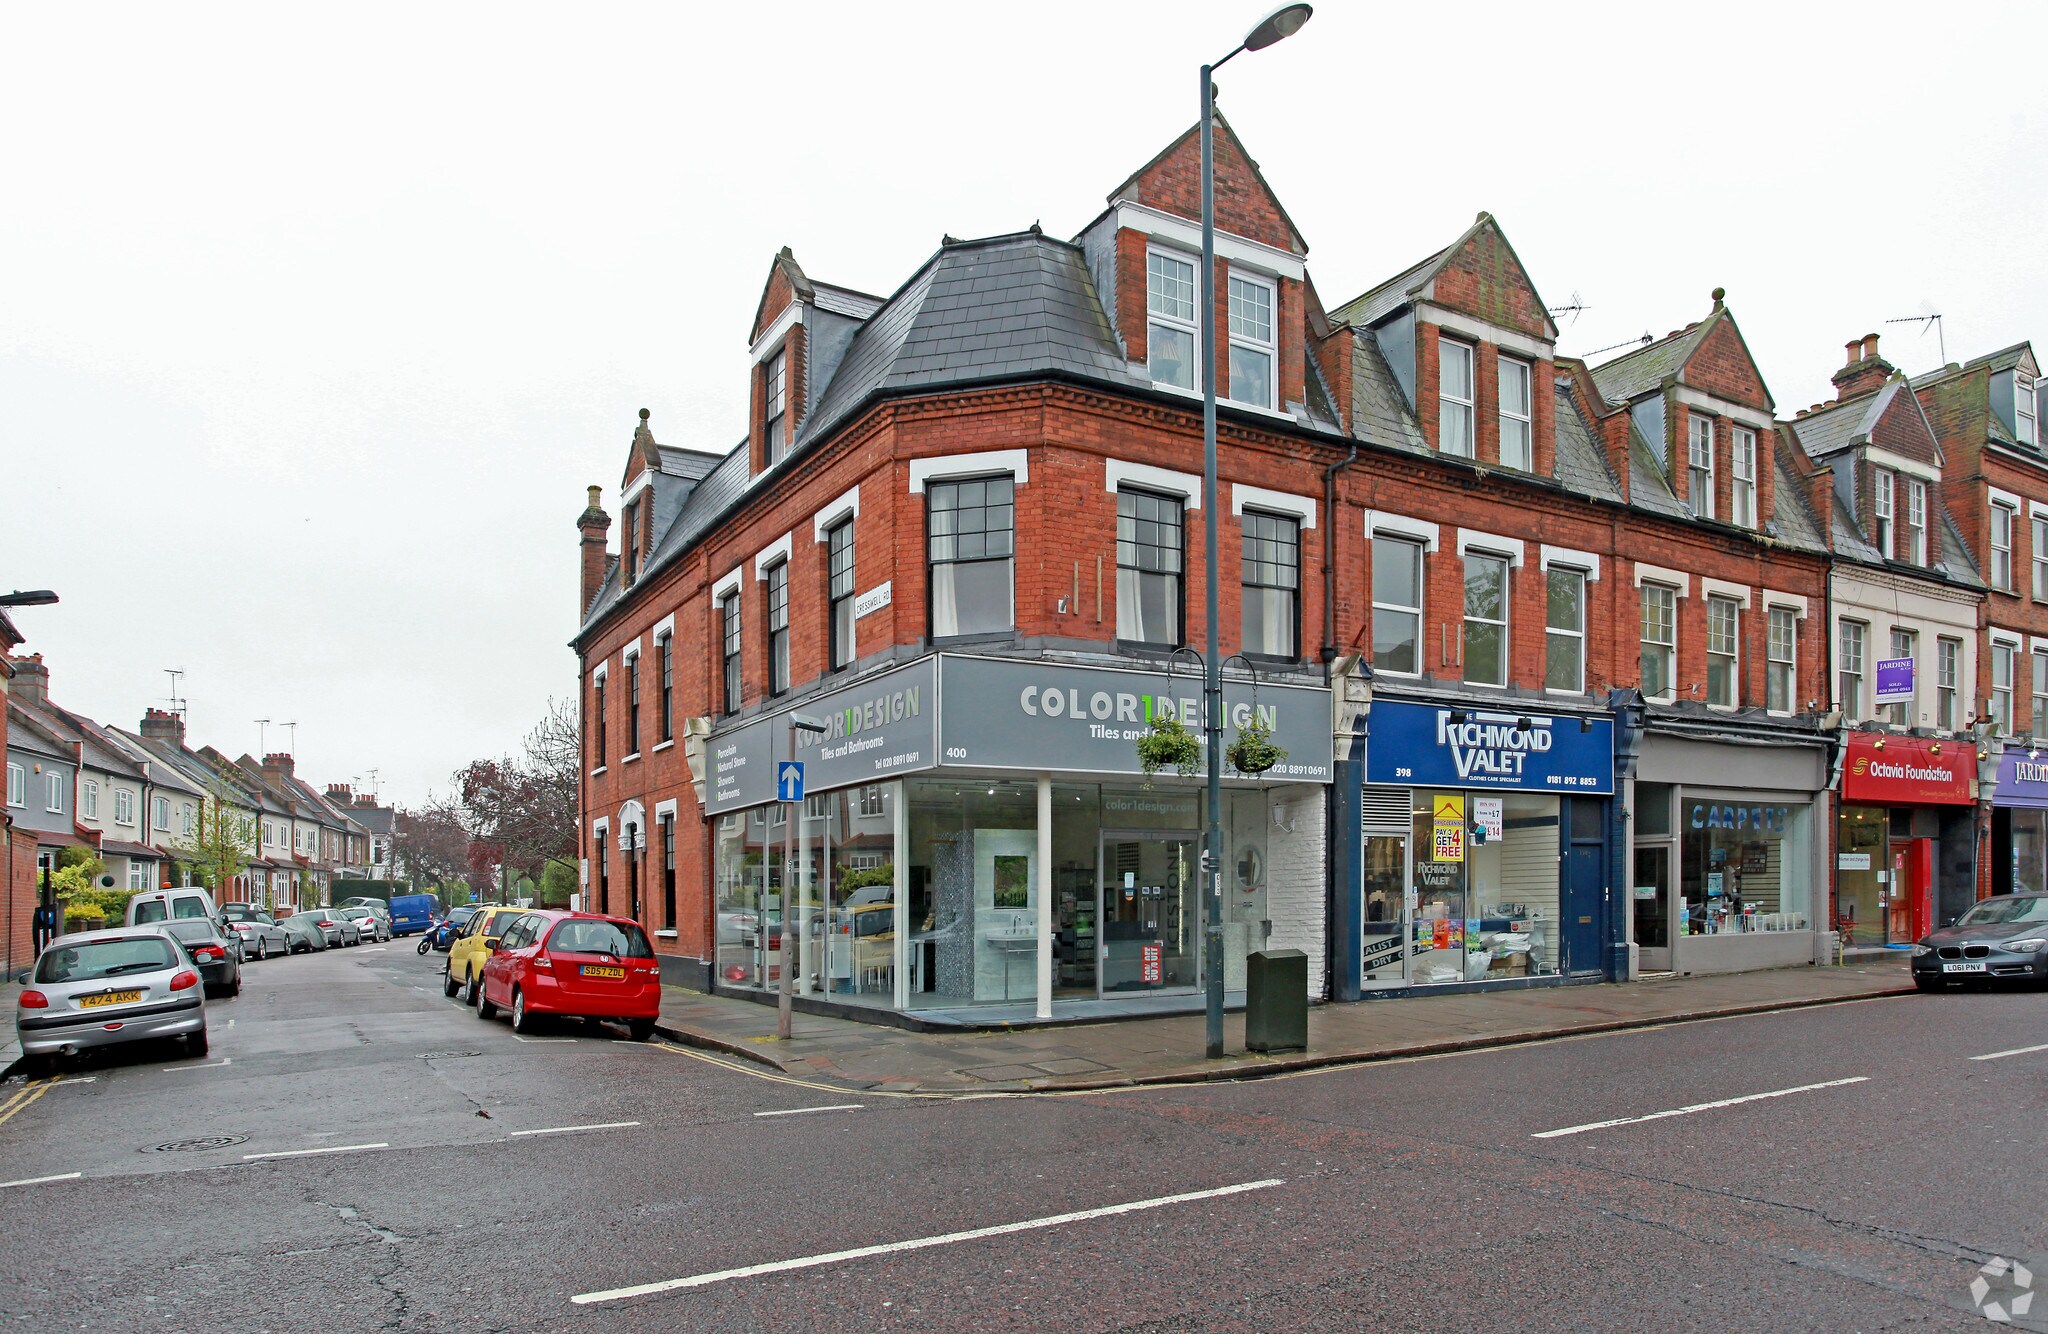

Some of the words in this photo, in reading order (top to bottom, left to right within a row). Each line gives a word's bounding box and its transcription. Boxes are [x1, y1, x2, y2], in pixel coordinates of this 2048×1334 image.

[1879, 661, 1911, 671] JARDINE
[1020, 686, 1277, 732] COLOR1DEIGN
[1090, 724, 1120, 740] Tiles
[1437, 711, 1552, 750] RICHMOND
[718, 744, 737, 759] Porcelain
[820, 747, 835, 761] Tiles
[835, 742, 848, 758] and
[848, 736, 884, 755] Bathrooms
[946, 747, 967, 758] 400
[718, 757, 734, 773] Natural
[734, 756, 746, 768] Stone
[883, 757, 892, 767] 020
[1452, 745, 1527, 778] VALET
[1272, 764, 1287, 774] 020
[1396, 768, 1411, 777] 398
[1870, 761, 1904, 779] Octavia
[1905, 764, 1953, 782] Foundation
[718, 775, 735, 787] Showers
[1547, 776, 1562, 784] 0181
[1564, 777, 1577, 785] 892
[1580, 777, 1597, 786] 8853
[718, 788, 740, 801] Bathrooms
[1105, 800, 1197, 814] color1design.com
[1691, 804, 1788, 833] CARPETS
[1487, 827, 1501, 836] £14
[1436, 836, 1452, 846] GET
[1436, 846, 1461, 857] FREE
[1418, 862, 1458, 874] RICHMOND
[1423, 874, 1450, 885] VALET
[1372, 954, 1392, 968] DRY
[585, 967, 606, 976] SD57
[607, 968, 623, 977] ZDL
[80, 995, 113, 1008] Y474
[116, 990, 140, 1002] AKK
